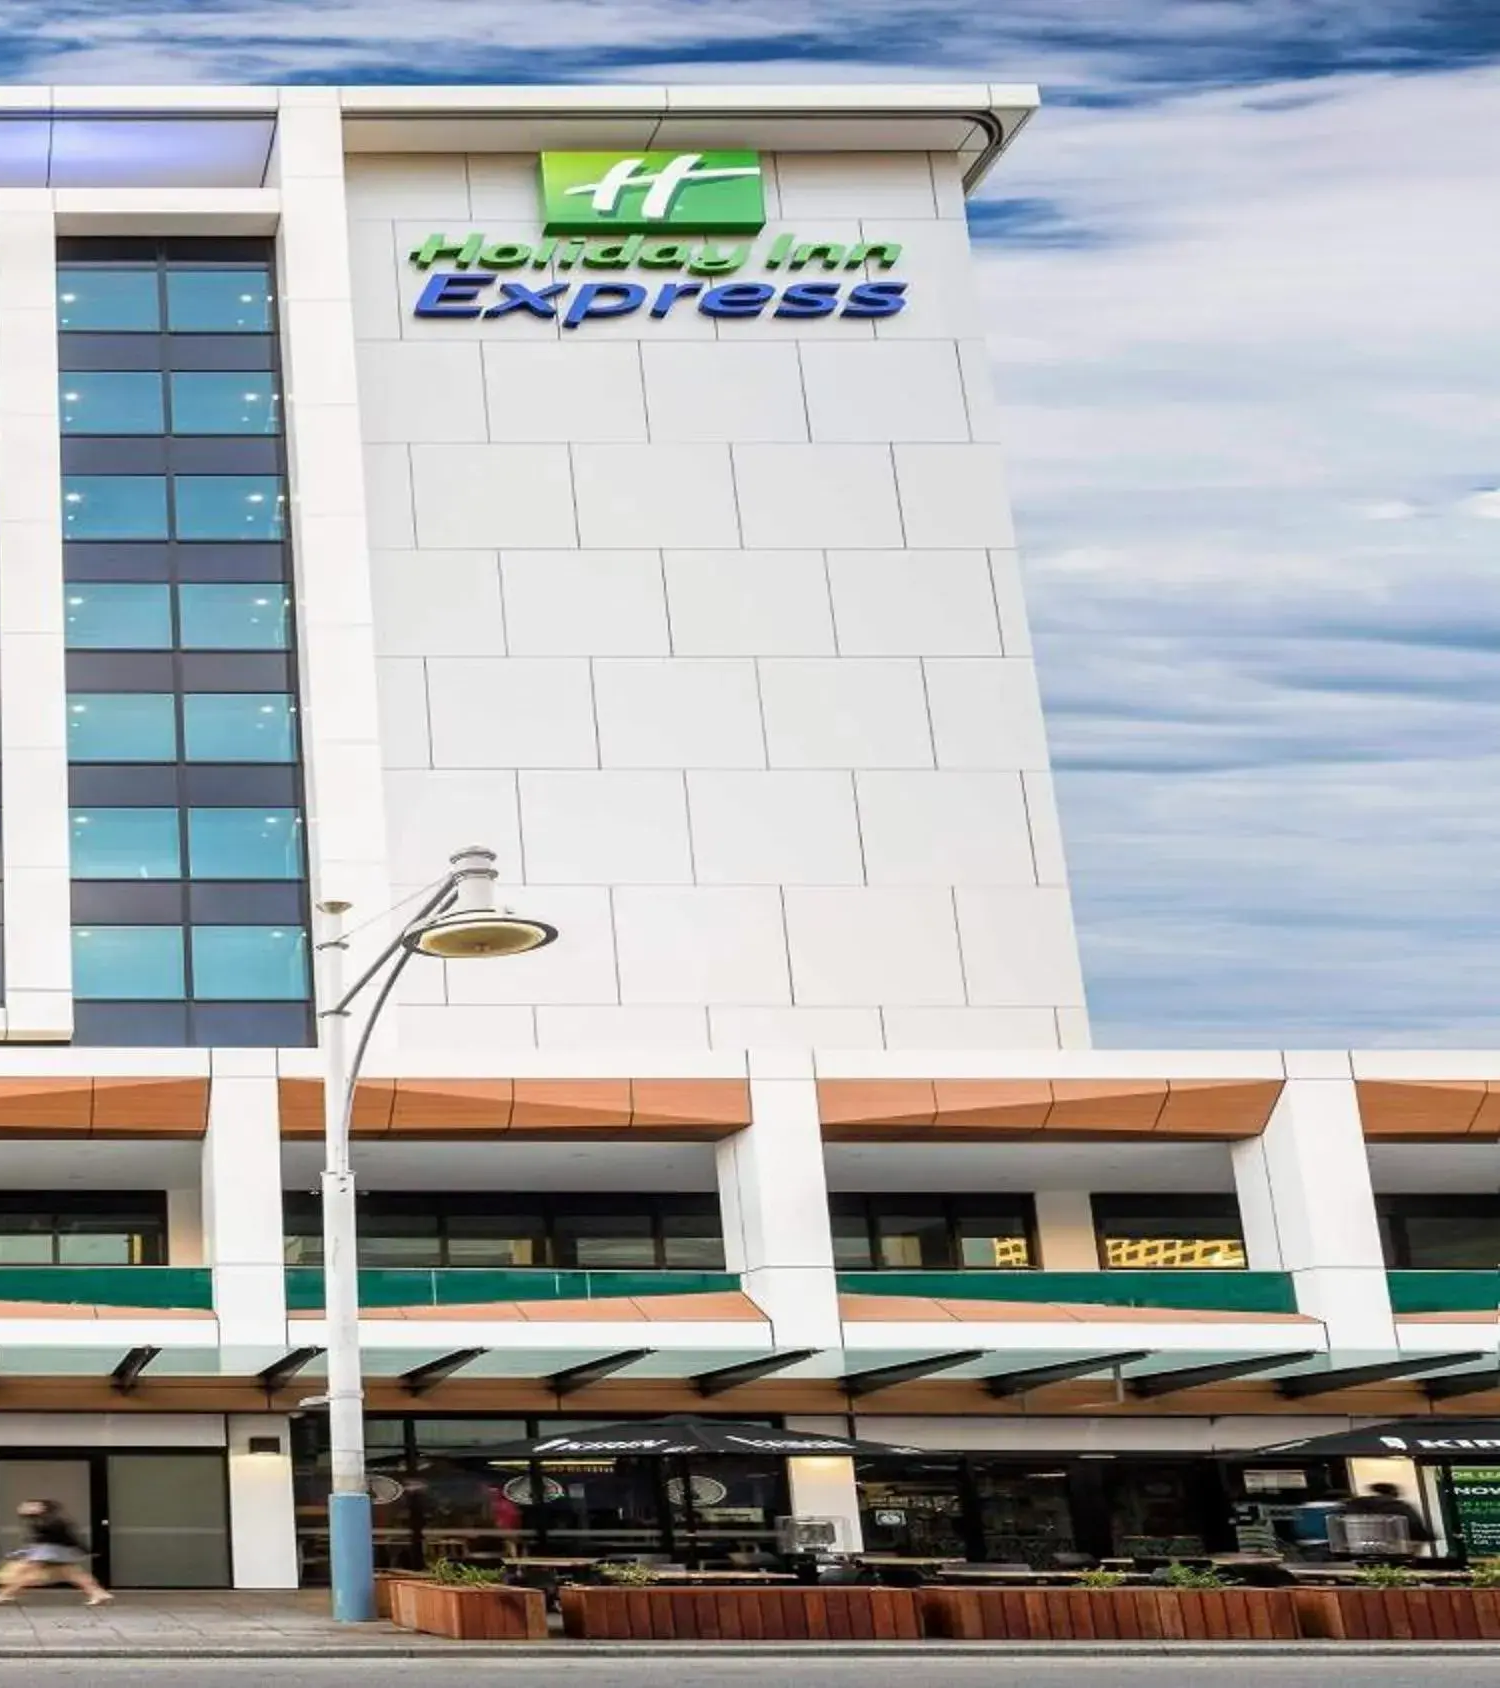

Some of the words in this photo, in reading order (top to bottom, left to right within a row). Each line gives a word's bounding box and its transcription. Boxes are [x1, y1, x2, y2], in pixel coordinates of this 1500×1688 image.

[410, 233, 751, 276] Holiday
[765, 233, 903, 271] Inn
[414, 273, 908, 328] Express
